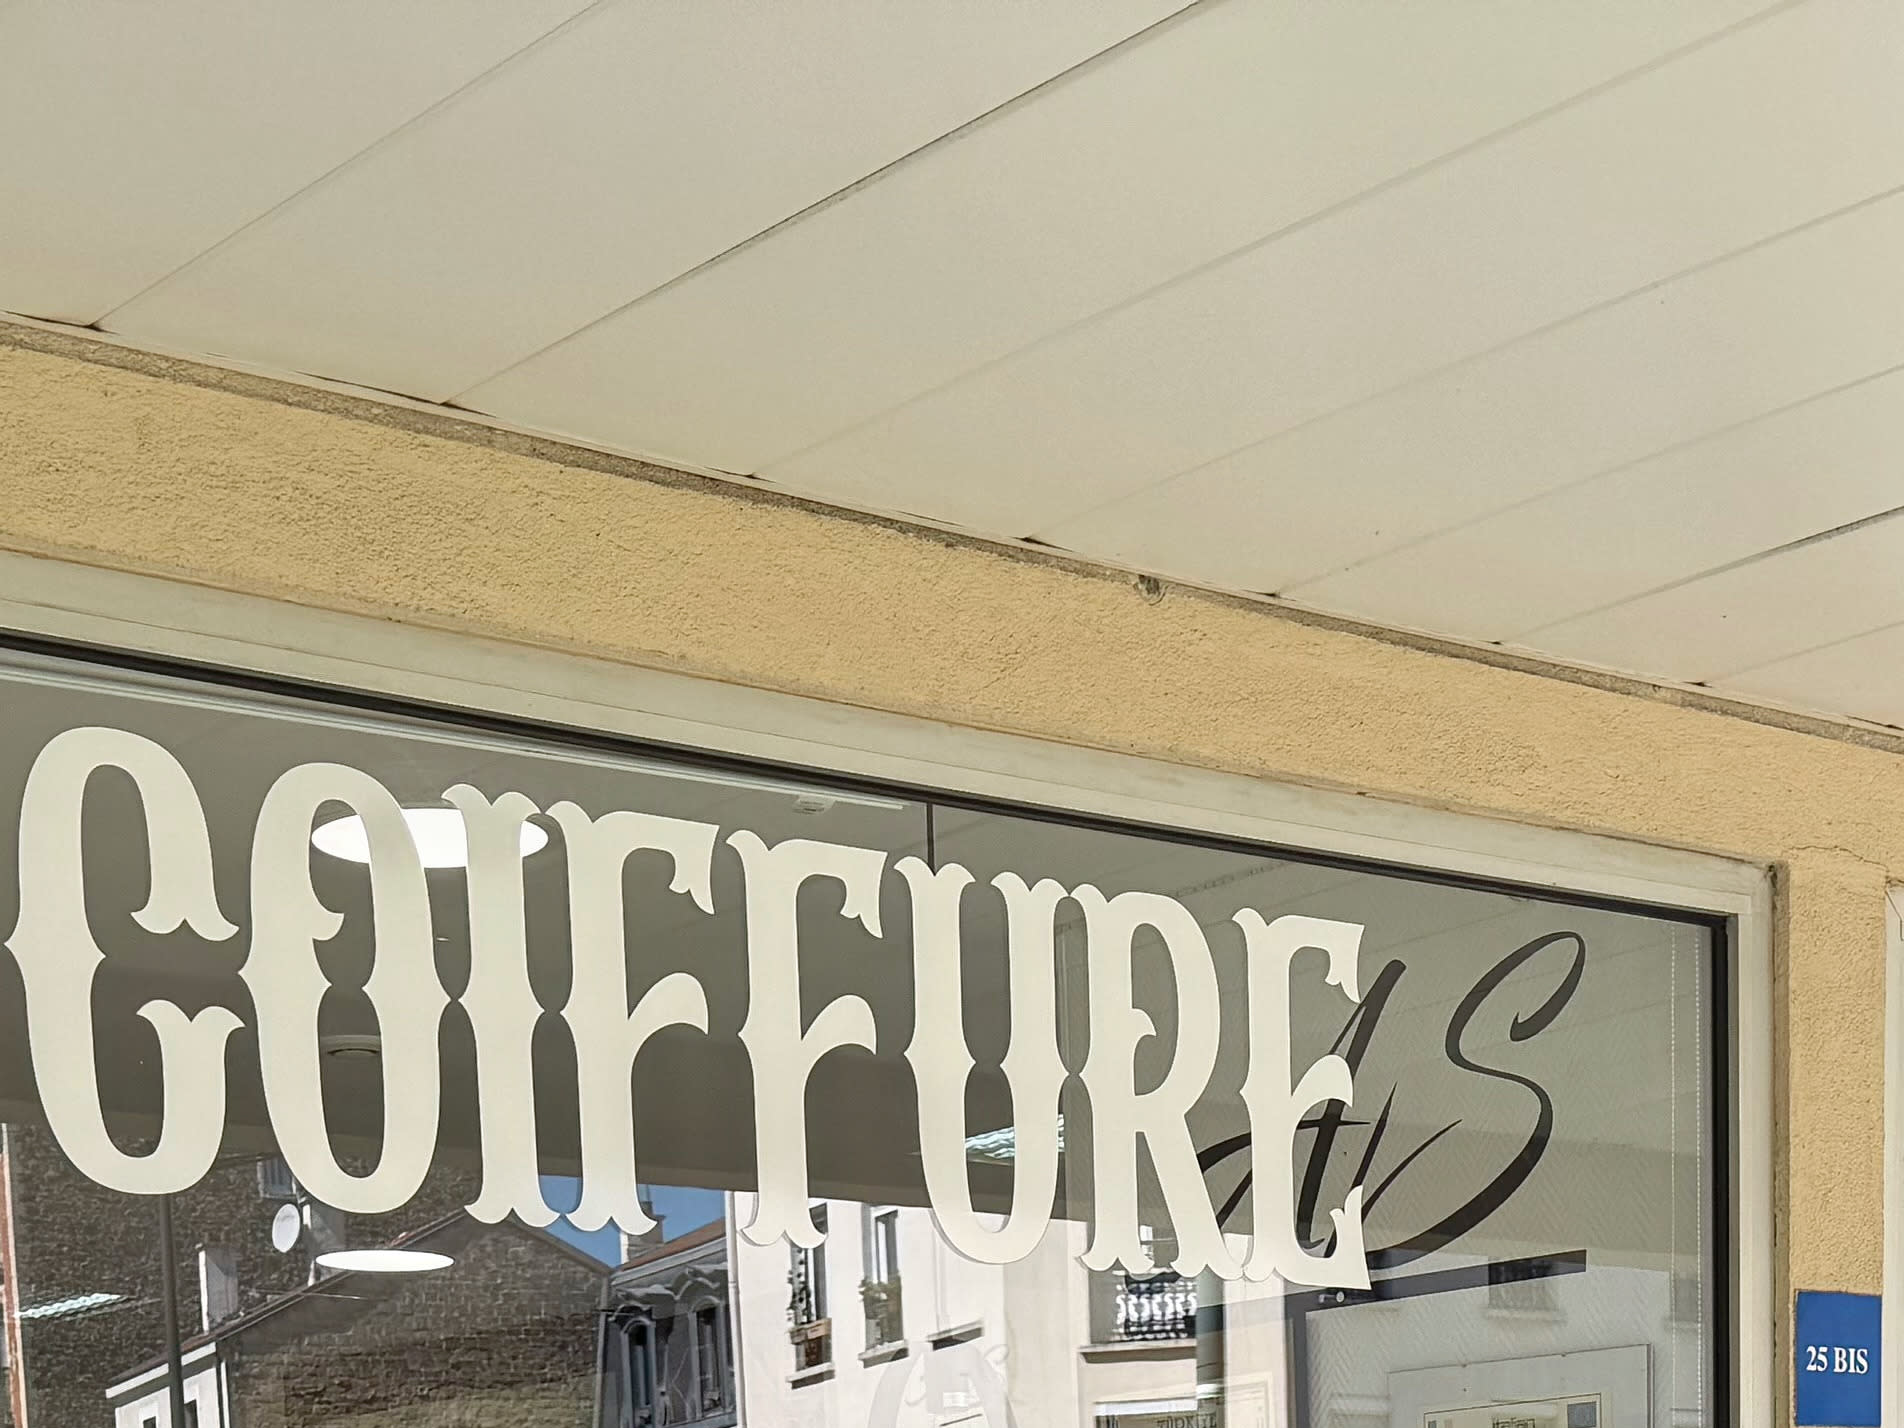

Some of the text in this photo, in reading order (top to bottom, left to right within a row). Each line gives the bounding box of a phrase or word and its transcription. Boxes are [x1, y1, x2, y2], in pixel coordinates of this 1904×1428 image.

[6, 725, 1371, 1291] COIFFURE
[1806, 1346, 1869, 1375] 25 BIS
